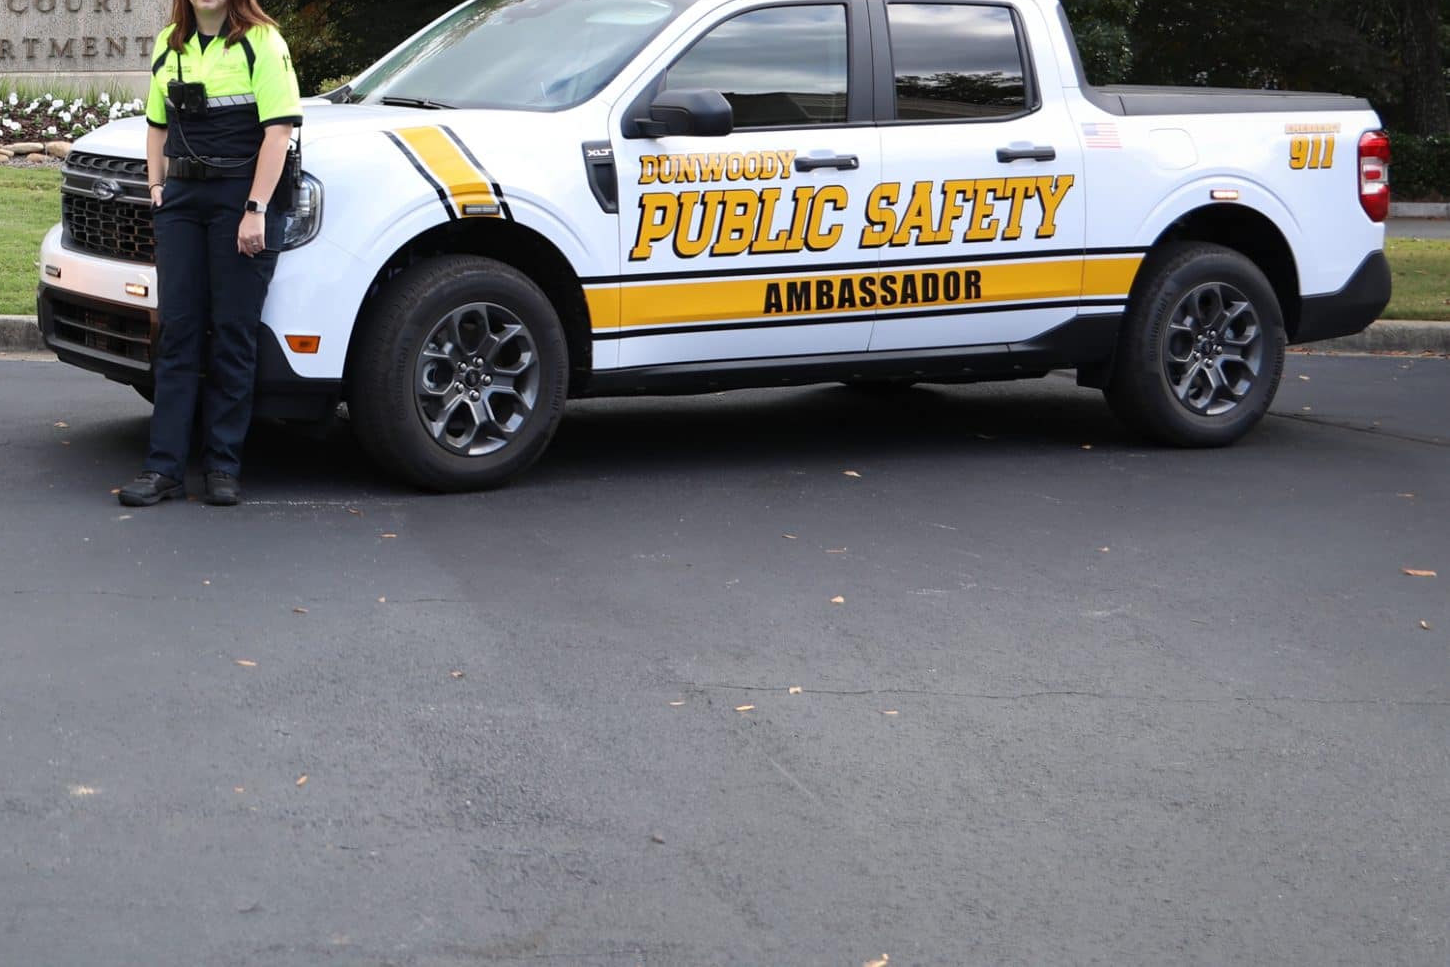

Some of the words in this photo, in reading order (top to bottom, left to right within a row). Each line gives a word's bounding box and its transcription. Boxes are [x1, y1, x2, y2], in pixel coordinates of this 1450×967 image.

[586, 148, 613, 157] XLT
[639, 149, 797, 184] DUNWOODY
[1288, 135, 1335, 170] 911
[628, 185, 849, 262] PUBLIC
[859, 174, 1076, 249] SAFETY
[763, 269, 982, 315] AMBASSADOR
